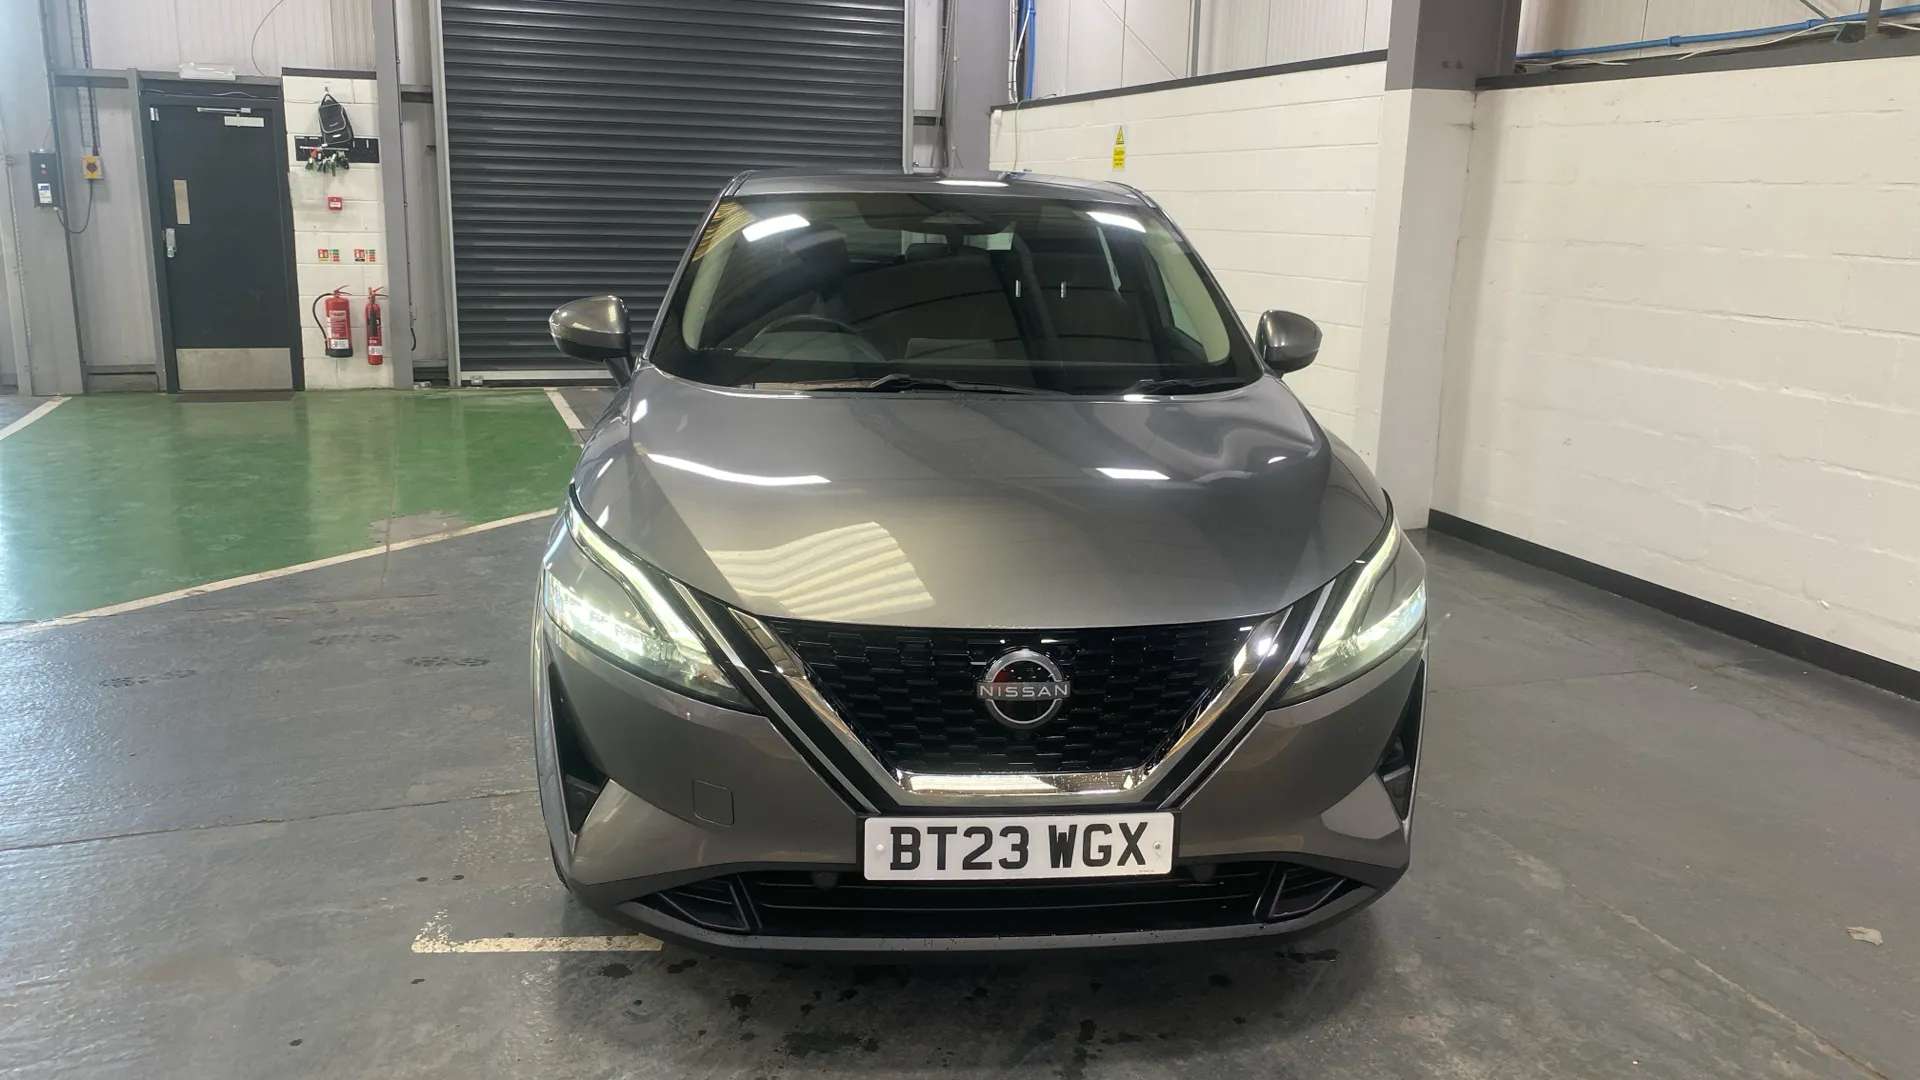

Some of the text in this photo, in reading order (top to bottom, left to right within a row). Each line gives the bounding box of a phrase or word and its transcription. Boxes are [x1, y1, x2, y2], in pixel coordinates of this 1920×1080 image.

[980, 684, 1068, 698] NISSAN
[890, 822, 1148, 870] BT23 WGX
